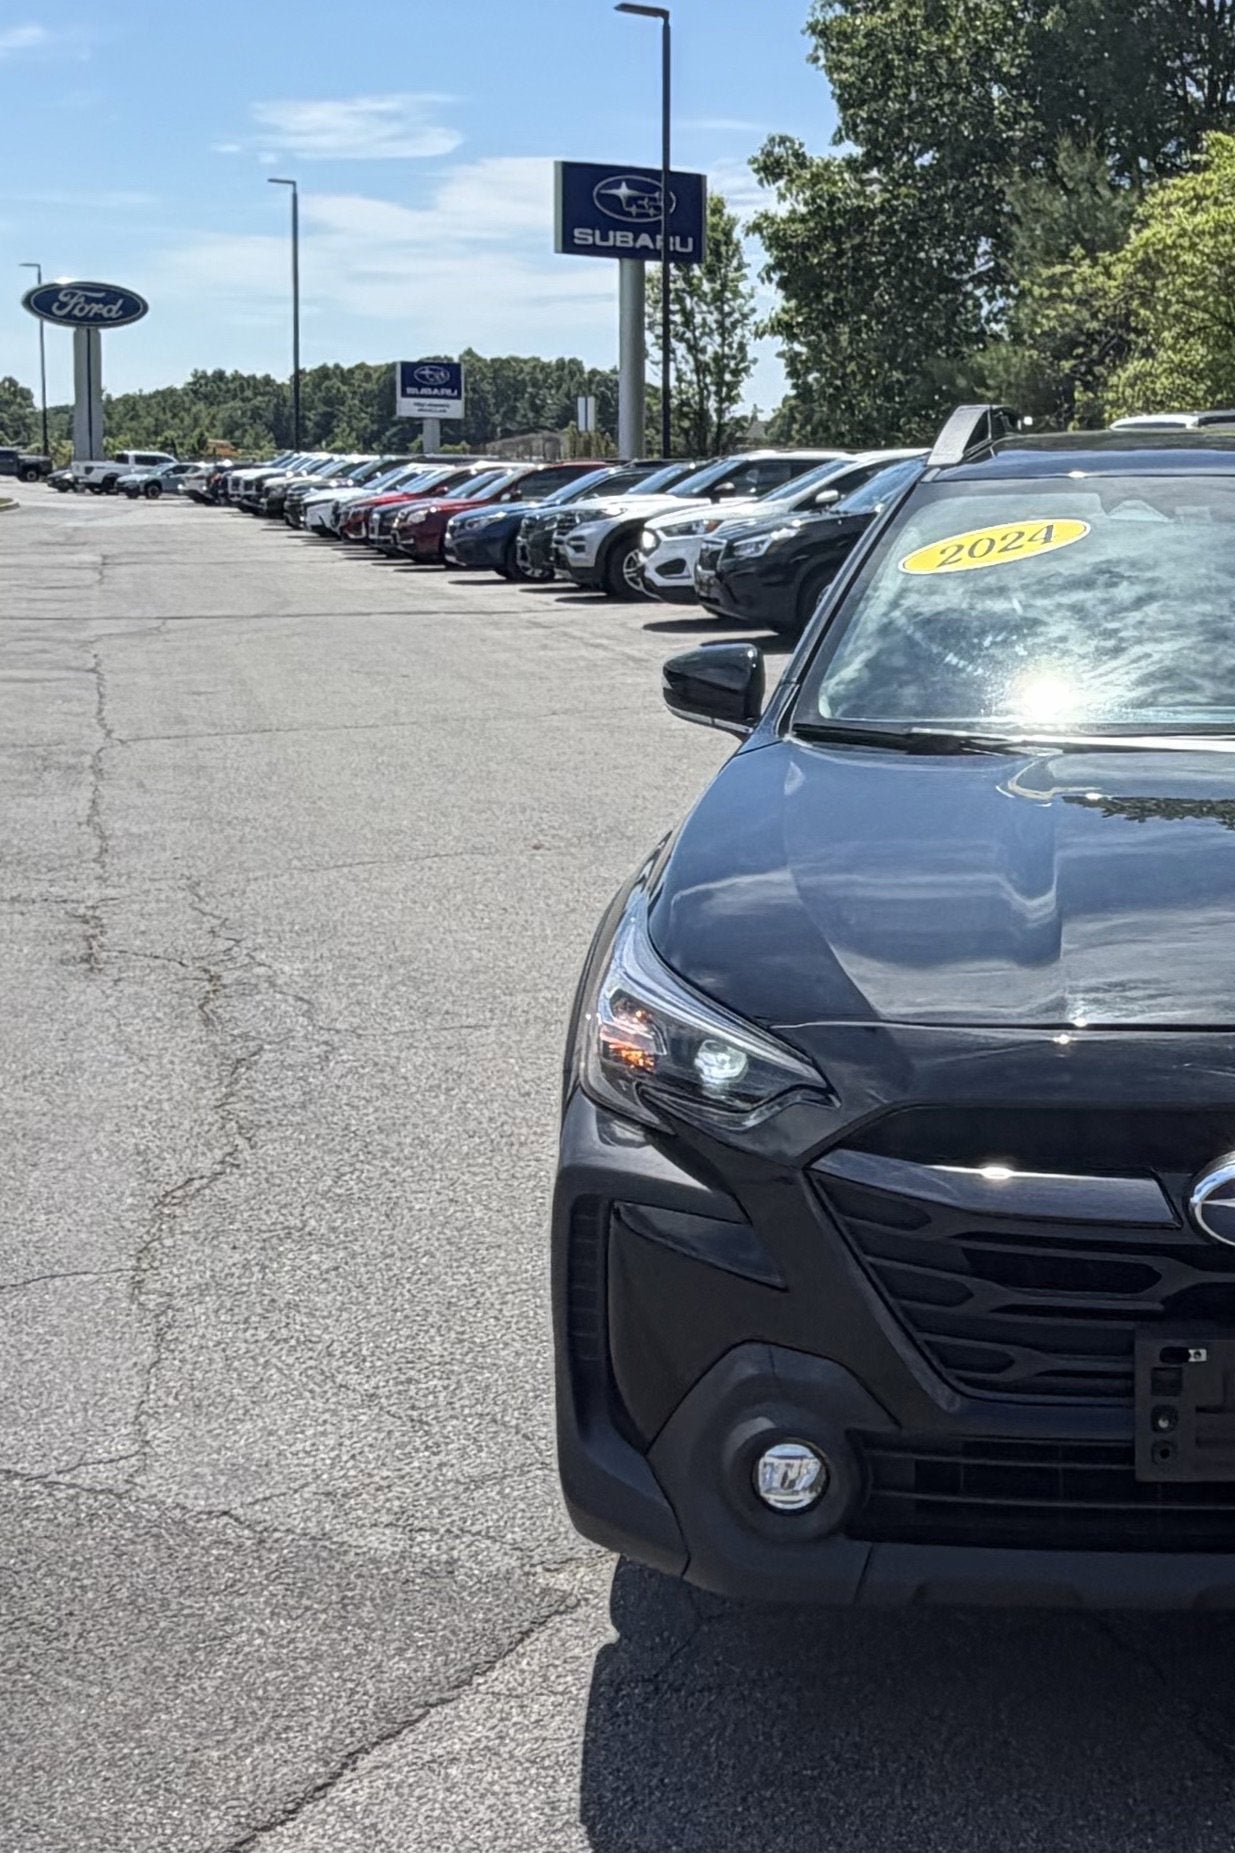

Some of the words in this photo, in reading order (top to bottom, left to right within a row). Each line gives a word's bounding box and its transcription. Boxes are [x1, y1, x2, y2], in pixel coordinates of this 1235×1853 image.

[573, 227, 693, 252] SUBARU
[51, 289, 124, 318] Ford
[406, 387, 458, 397] SUBARU
[937, 524, 1054, 568] 2024
